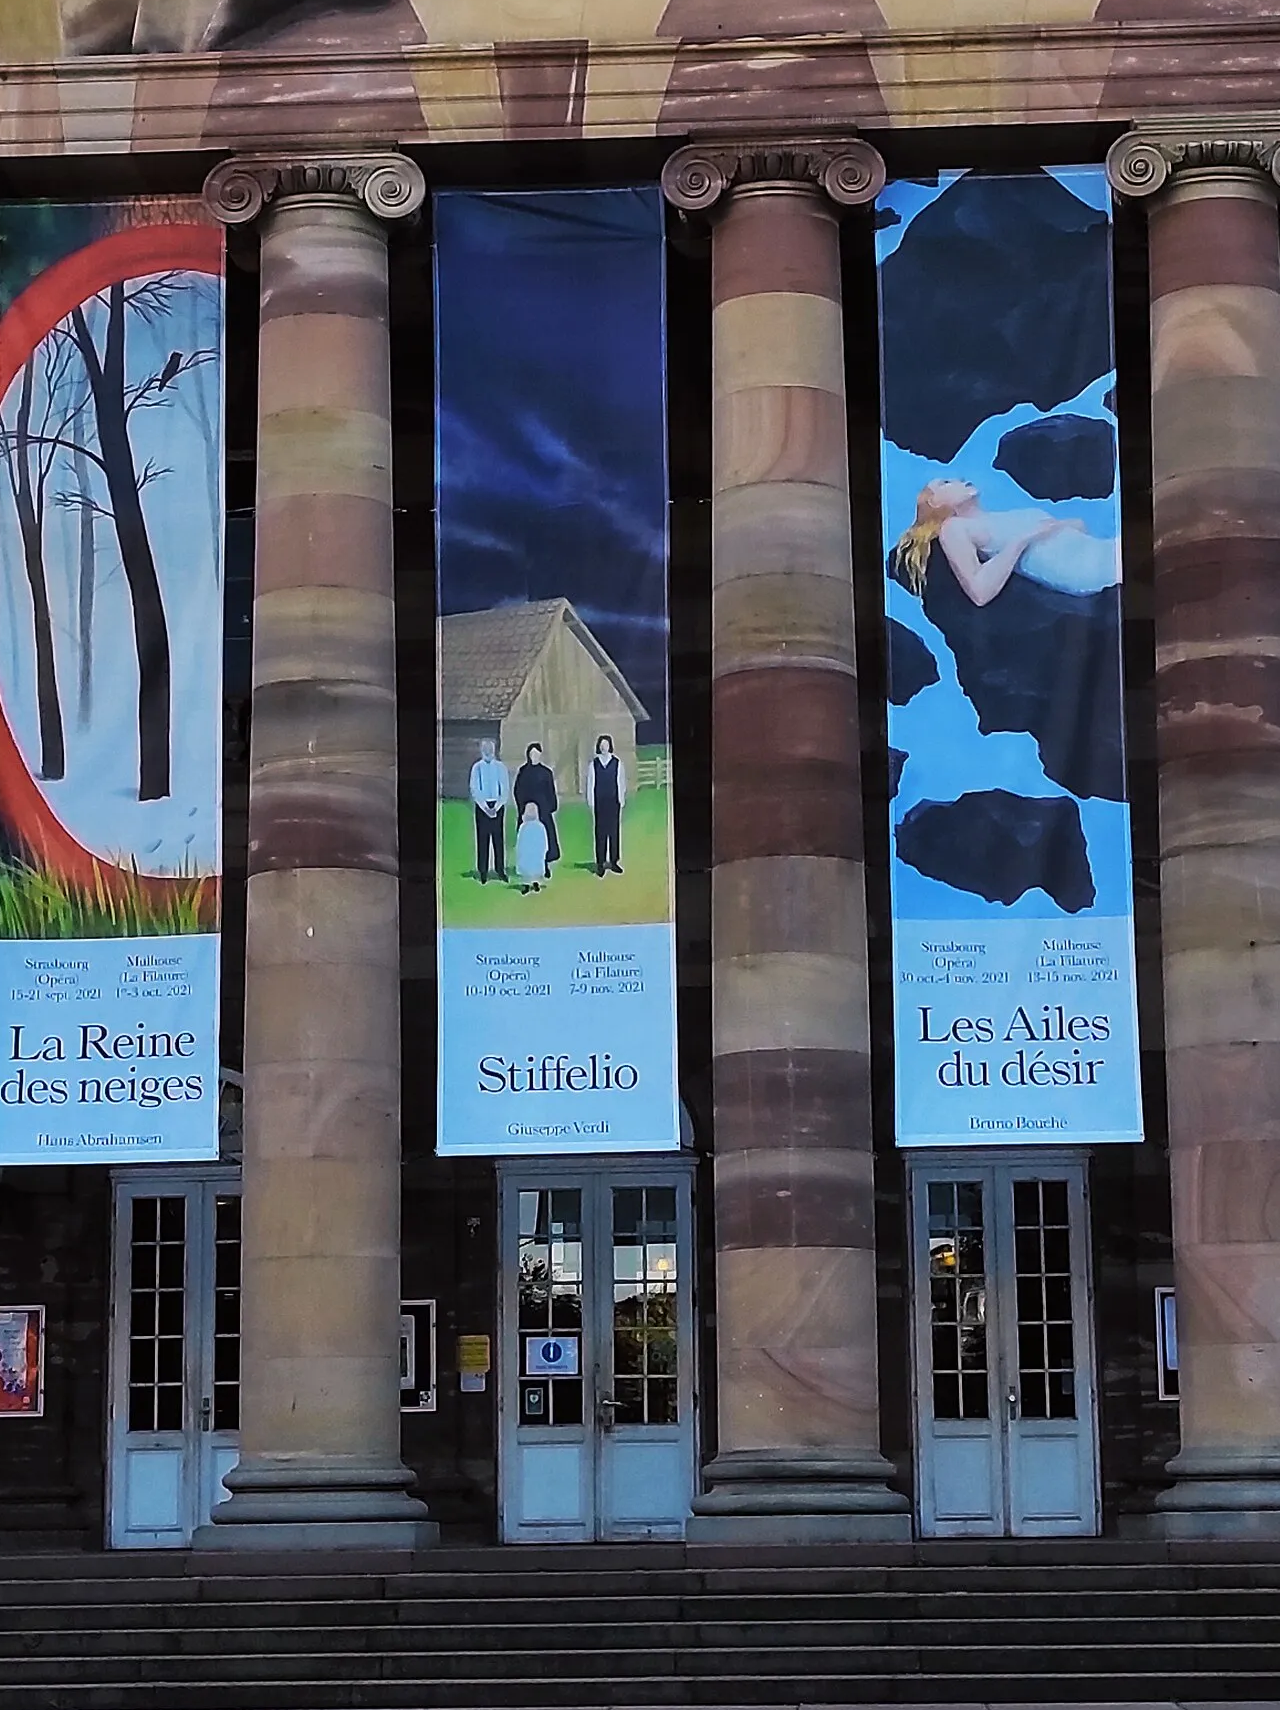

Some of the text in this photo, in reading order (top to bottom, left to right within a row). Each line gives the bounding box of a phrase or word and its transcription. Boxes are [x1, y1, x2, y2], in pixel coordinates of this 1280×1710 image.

[921, 941, 986, 954] Strasbourg
[1042, 938, 1101, 951] Mulhouse
[126, 955, 183, 967] Mulhouse
[476, 954, 540, 967] Strasbourg
[578, 951, 636, 963] Mulhouse
[25, 958, 89, 971] Strasbourg
[982, 971, 1009, 983] 2021
[1091, 970, 1118, 981] 2021
[75, 988, 101, 1000] 2021
[167, 985, 191, 997] 2021
[525, 985, 551, 996] 2021
[618, 982, 644, 993] 2021
[918, 1005, 1110, 1042] Les Ailes
[9, 1022, 195, 1061] La Reine
[478, 1053, 639, 1092] Stiffelio
[938, 1048, 1104, 1086] du désir
[0, 1066, 203, 1108] des neiges
[508, 1121, 610, 1136] Giuseppe Verdi
[970, 1117, 1013, 1130] Bruno
[37, 1133, 162, 1147] Hans Abrahamsen
